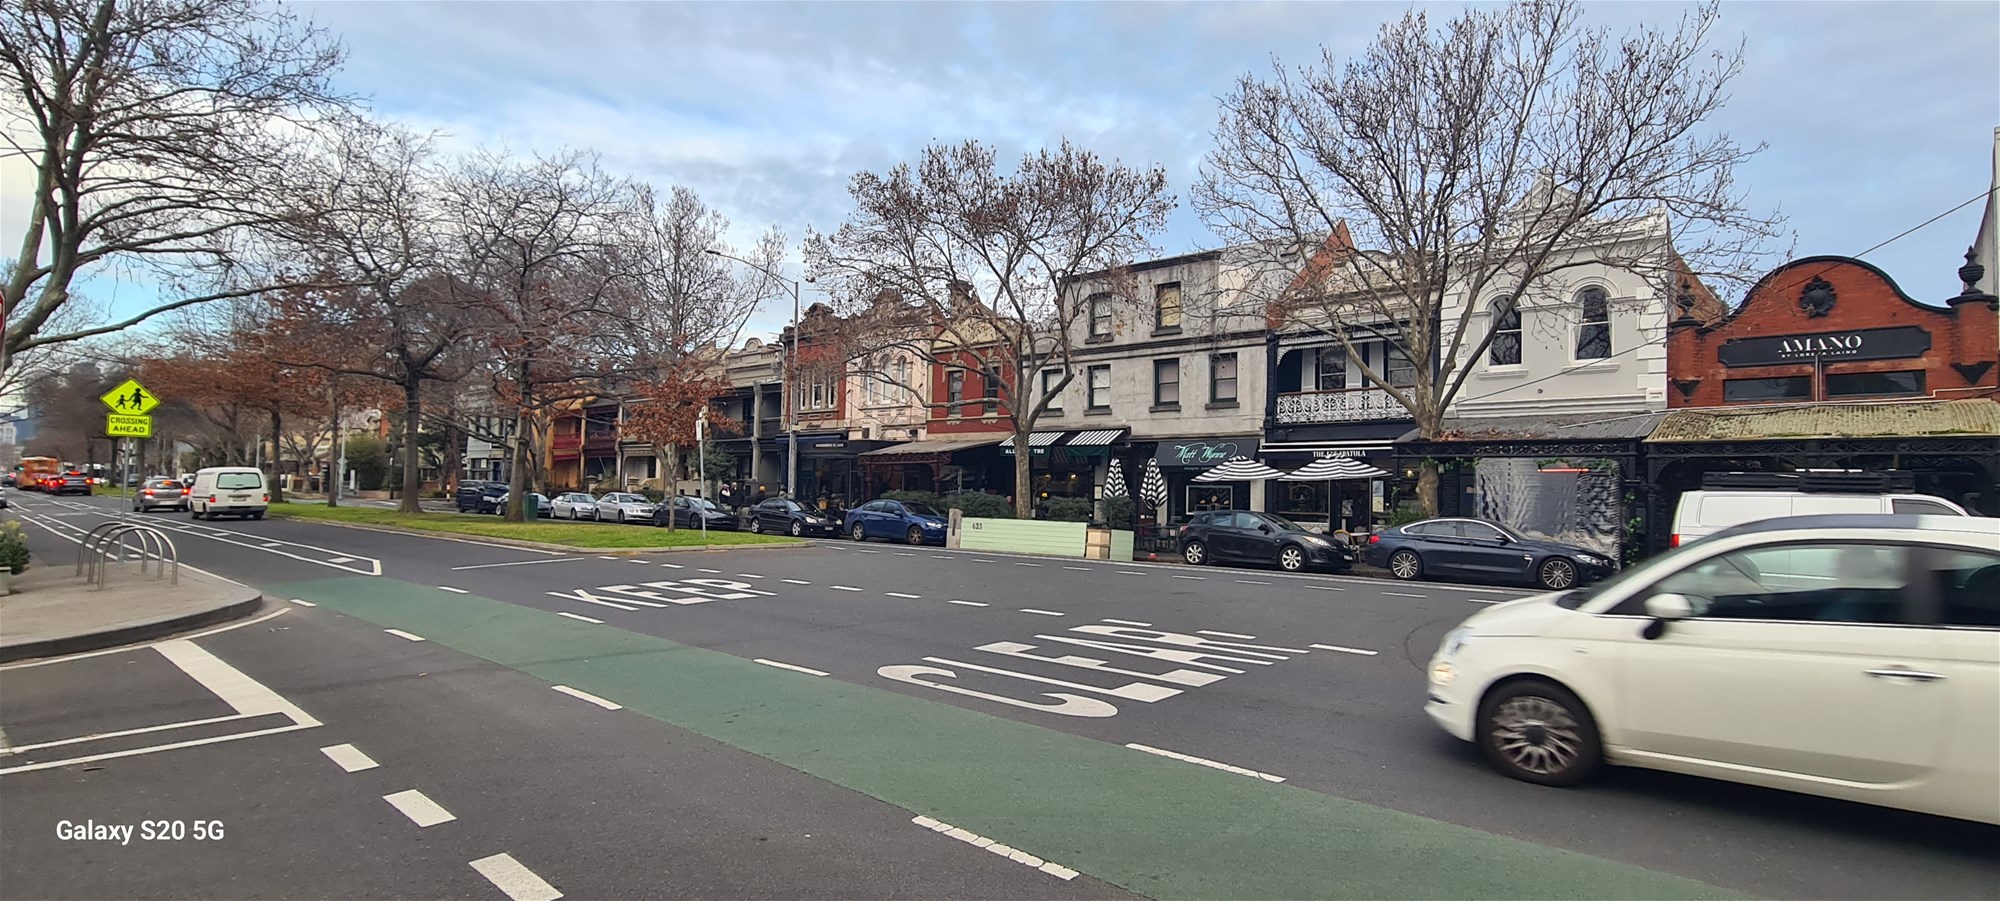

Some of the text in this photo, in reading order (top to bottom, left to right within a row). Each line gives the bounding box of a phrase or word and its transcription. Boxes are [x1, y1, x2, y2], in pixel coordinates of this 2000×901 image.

[1778, 335, 1862, 352] AMANO
[110, 416, 148, 425] CROSSING
[113, 425, 145, 433] AHEAD
[545, 578, 778, 612] KEEP
[877, 625, 1309, 717] CLEAR
